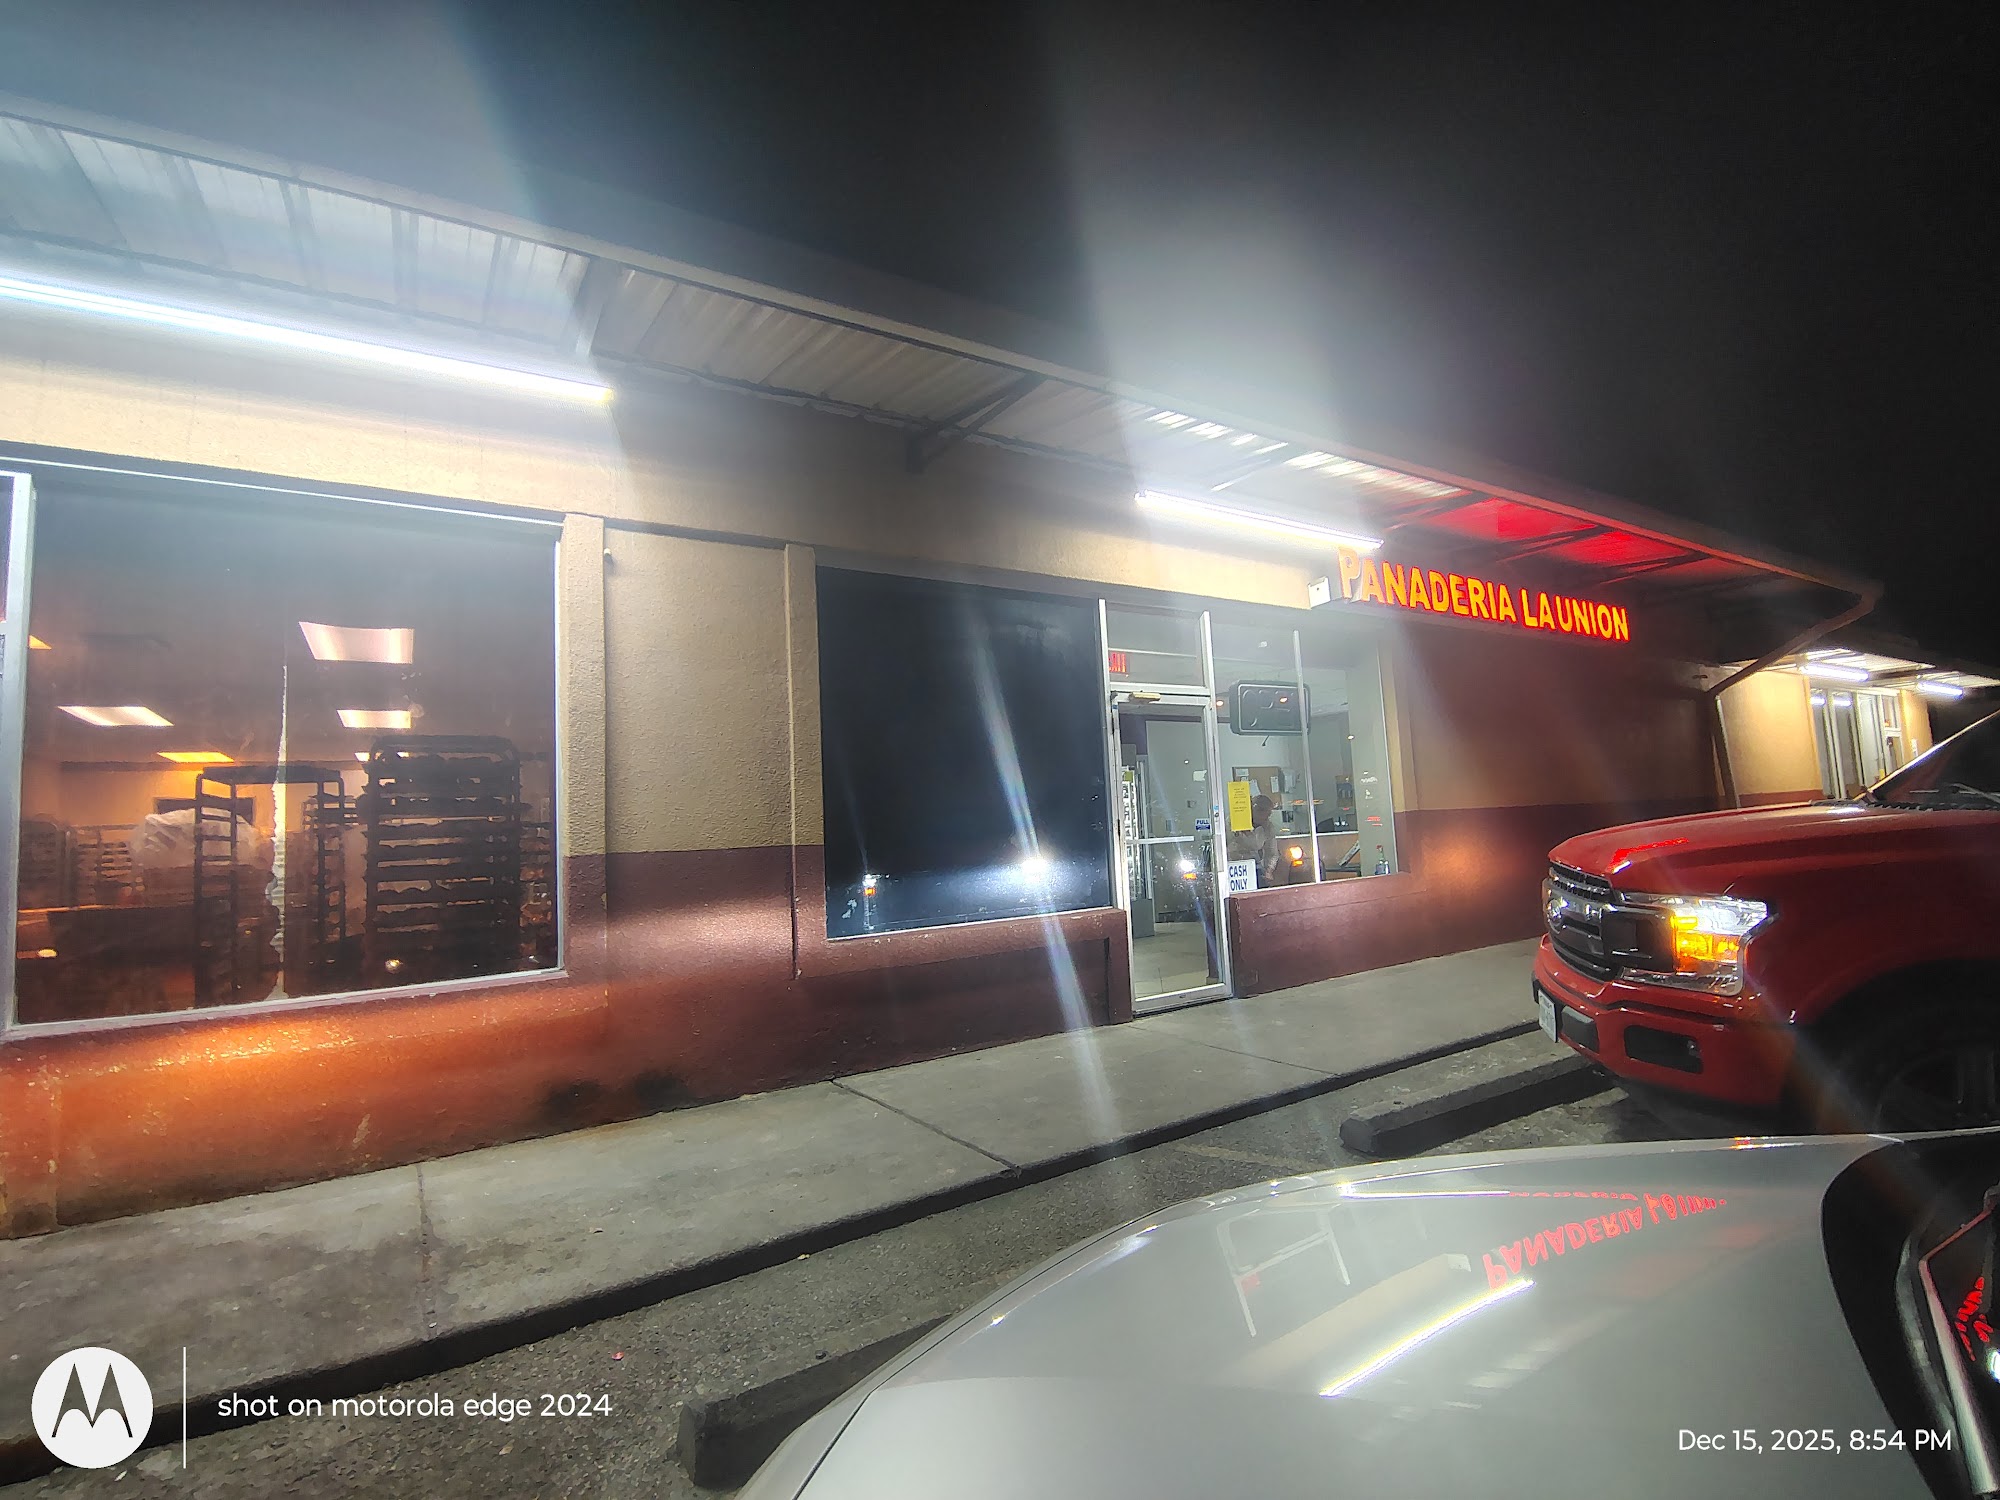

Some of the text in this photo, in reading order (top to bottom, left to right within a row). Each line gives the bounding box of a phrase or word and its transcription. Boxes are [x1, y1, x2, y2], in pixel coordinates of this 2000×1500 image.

[1336, 546, 1517, 623] PANADERIA
[1228, 865, 1248, 878] CASH
[1230, 878, 1248, 891] ONLY
